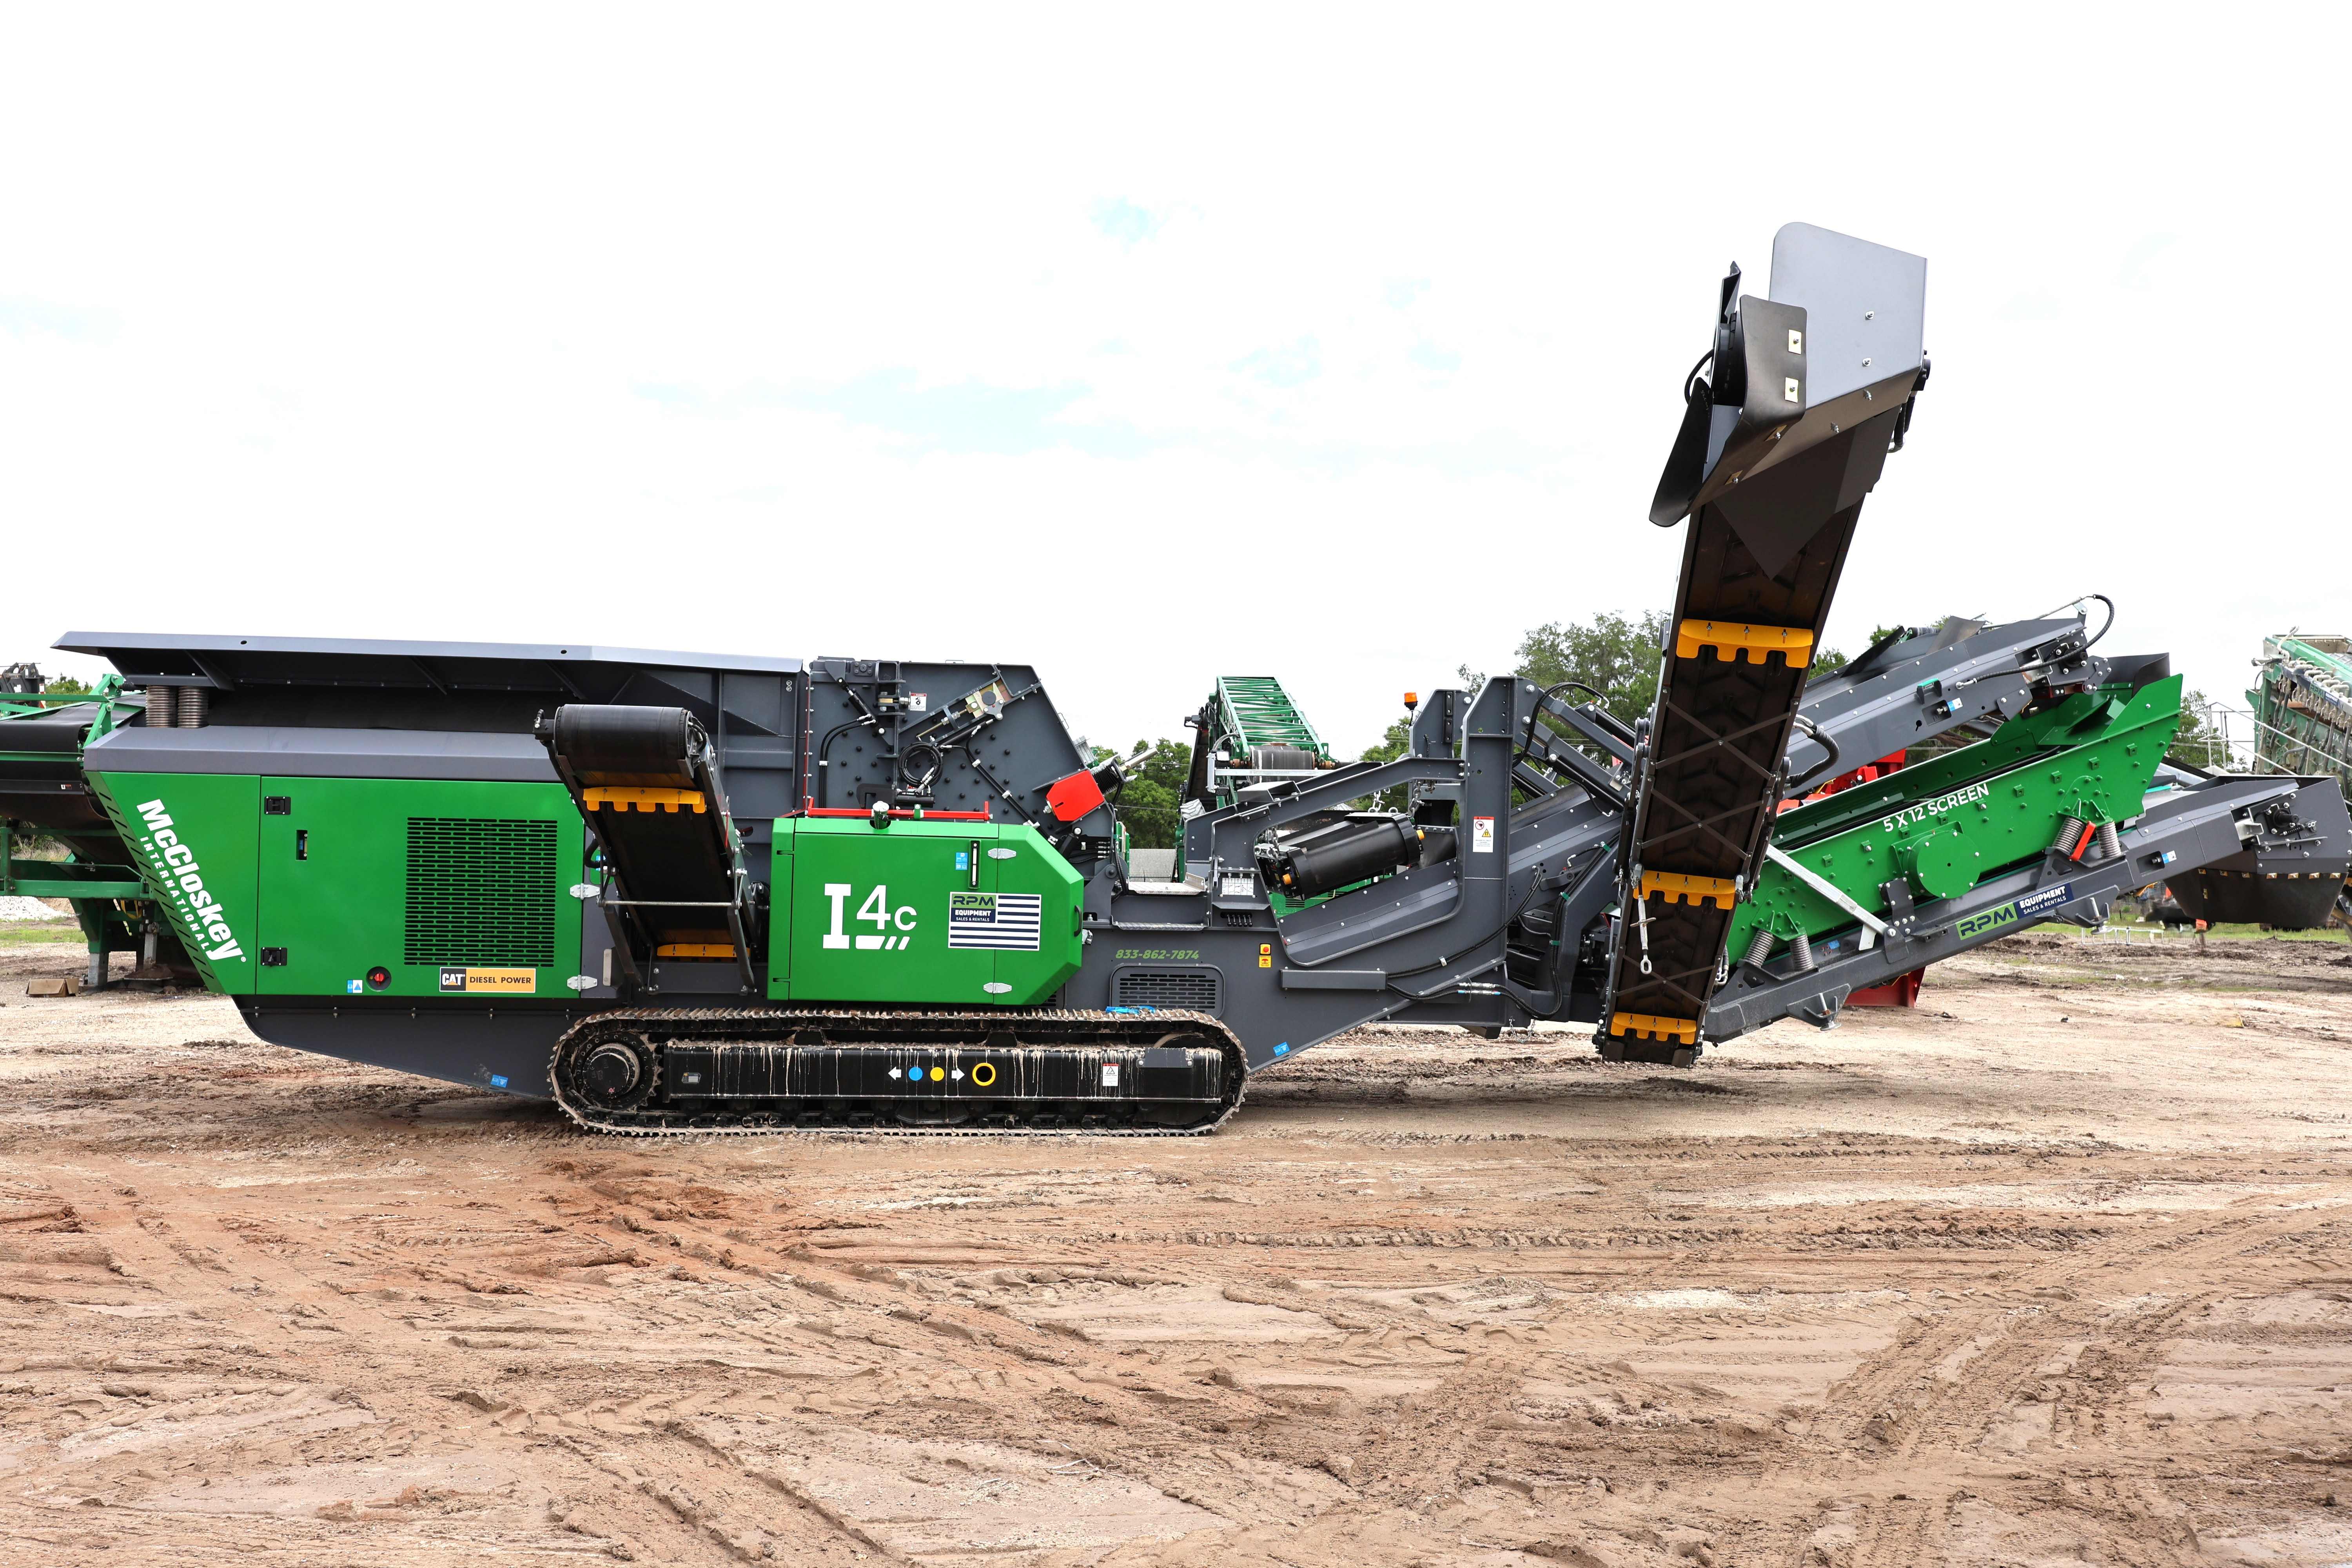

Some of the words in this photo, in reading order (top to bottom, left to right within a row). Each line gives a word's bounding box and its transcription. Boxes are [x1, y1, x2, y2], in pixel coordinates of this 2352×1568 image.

[1883, 818, 1893, 832] 5
[1895, 813, 1908, 828] X
[1908, 807, 1926, 822] 12
[1927, 783, 1989, 815] SCREEN
[137, 799, 243, 960] McCloskey
[140, 837, 210, 950] INTERNATIONAL
[953, 896, 994, 906] RPM
[2019, 886, 2065, 908] EQUIPMENT
[2024, 905, 2039, 914] SALES
[2045, 896, 2066, 906] RENTALS
[1960, 907, 2014, 936] RPM
[1116, 949, 1199, 959] 833-862-7874
[442, 973, 463, 985] CAT
